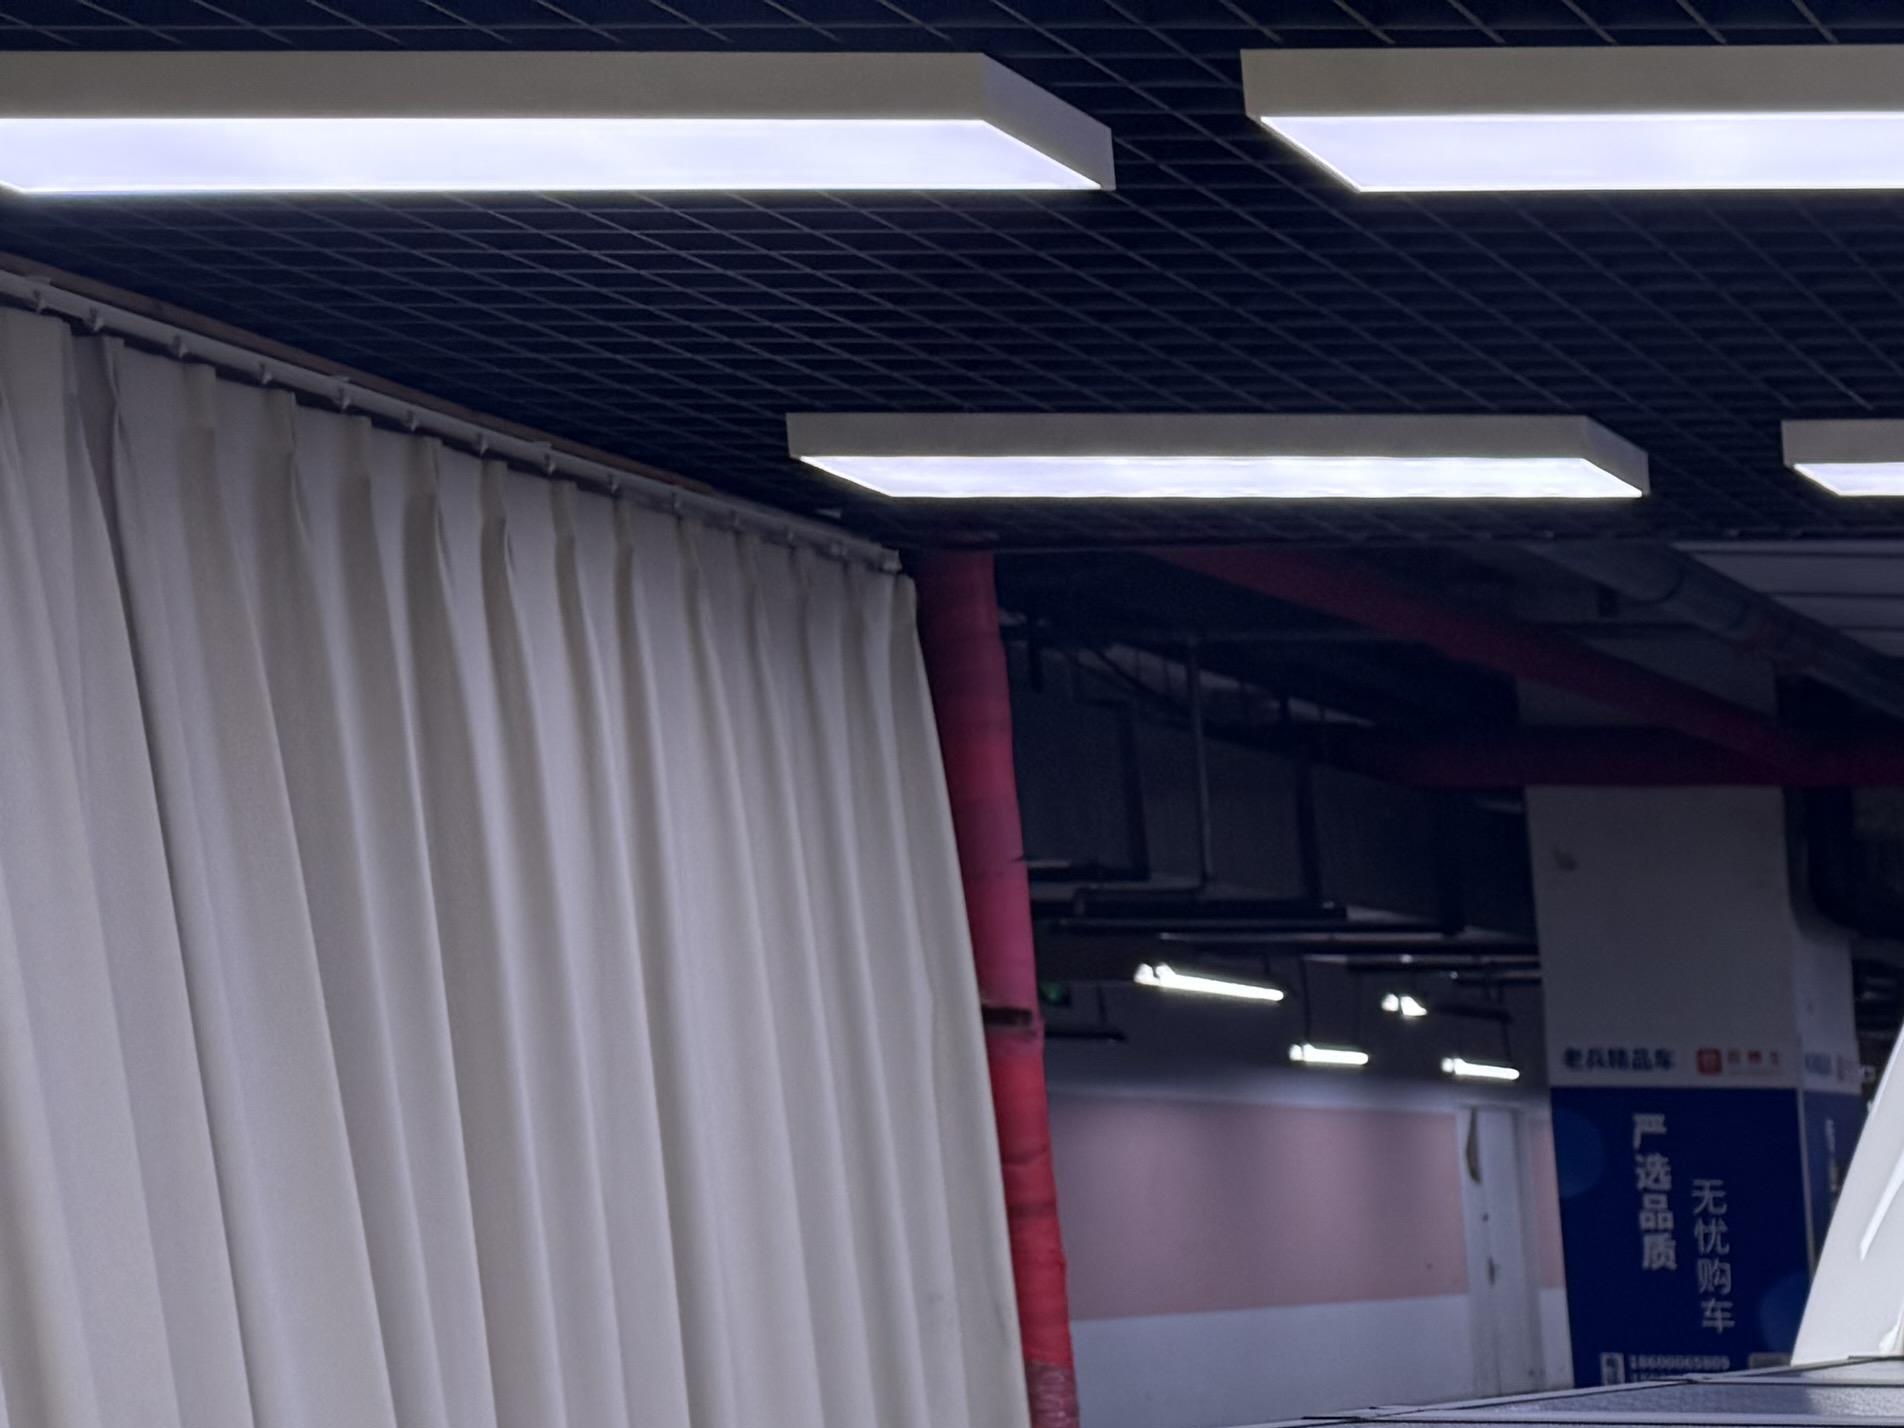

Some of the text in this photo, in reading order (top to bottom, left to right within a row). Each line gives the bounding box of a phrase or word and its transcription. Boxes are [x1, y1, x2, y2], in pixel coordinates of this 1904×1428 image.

[1632, 1113, 1678, 1270] 严选品质
[1691, 1178, 1735, 1333] 无忧购车
